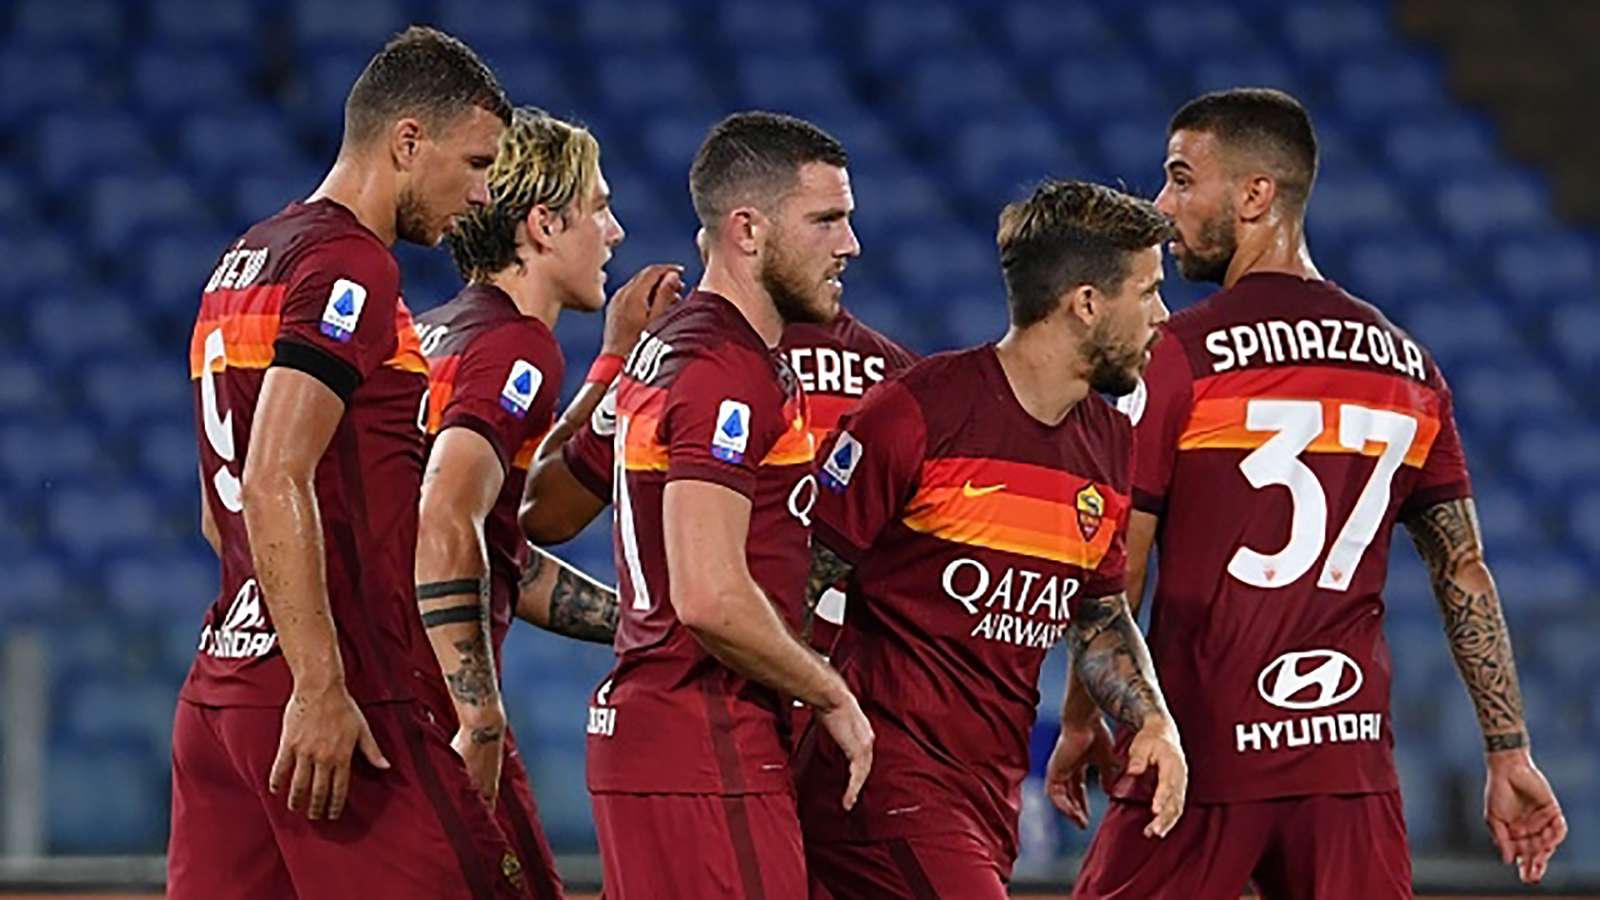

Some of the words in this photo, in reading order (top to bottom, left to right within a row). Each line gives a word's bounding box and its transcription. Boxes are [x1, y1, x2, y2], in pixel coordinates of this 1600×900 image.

[790, 347, 885, 395] ERES
[1206, 319, 1426, 380] SPINAZZOLA
[1227, 399, 1418, 591] 37
[942, 558, 1080, 620] QATAR
[1235, 713, 1381, 752] HYUNDAI
